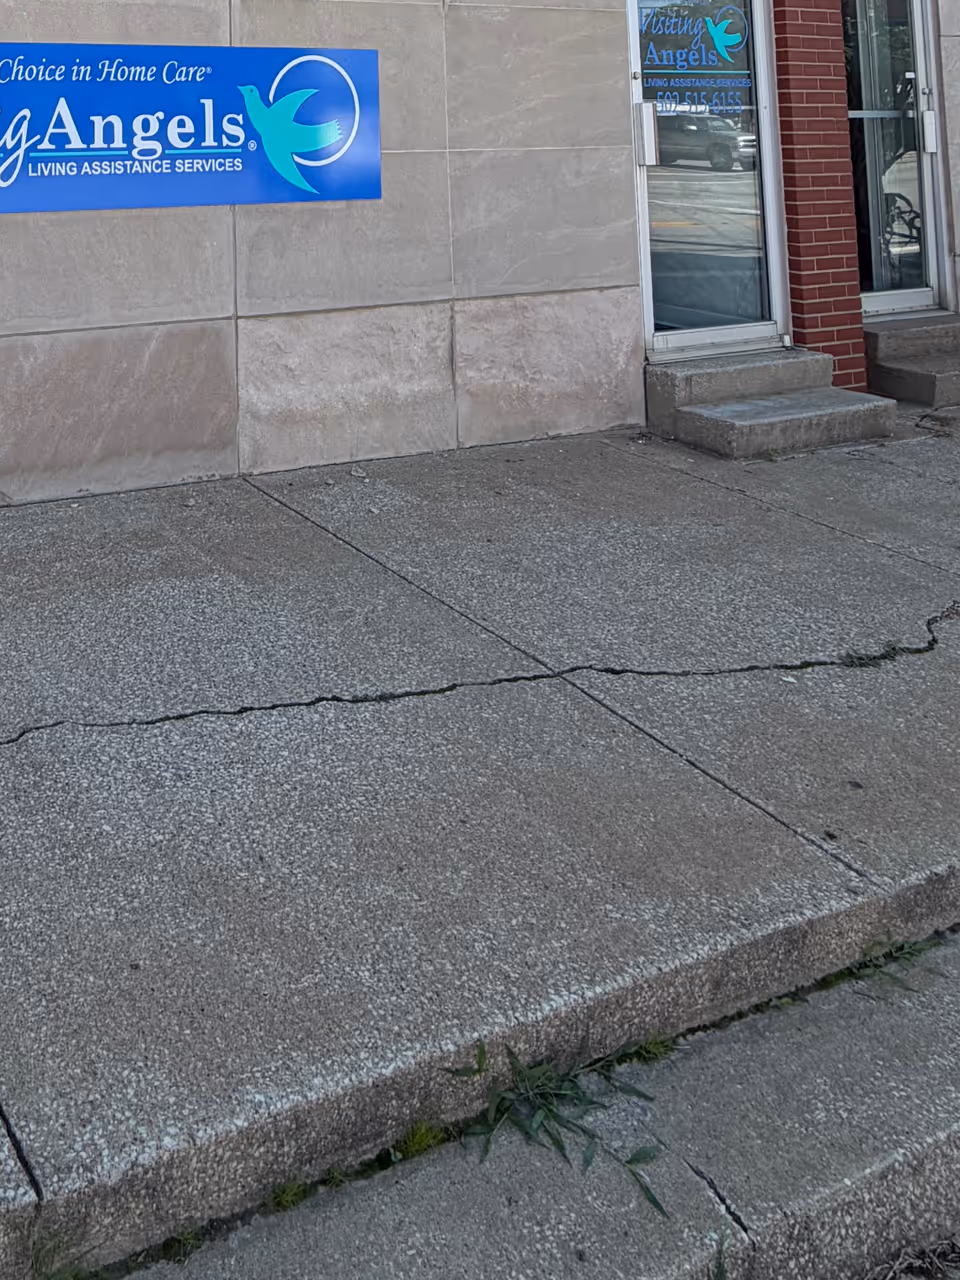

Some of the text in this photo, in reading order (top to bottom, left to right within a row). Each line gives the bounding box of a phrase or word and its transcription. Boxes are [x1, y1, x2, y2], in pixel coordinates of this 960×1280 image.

[640, 7, 706, 50] Visiting
[644, 41, 719, 70] Angels
[71, 58, 92, 82] in
[96, 58, 156, 82] Home
[643, 78, 752, 88] LIVING ASSISTANCE SERVICES
[28, 158, 243, 177] LIVING ASSISTANCE SERVICES
